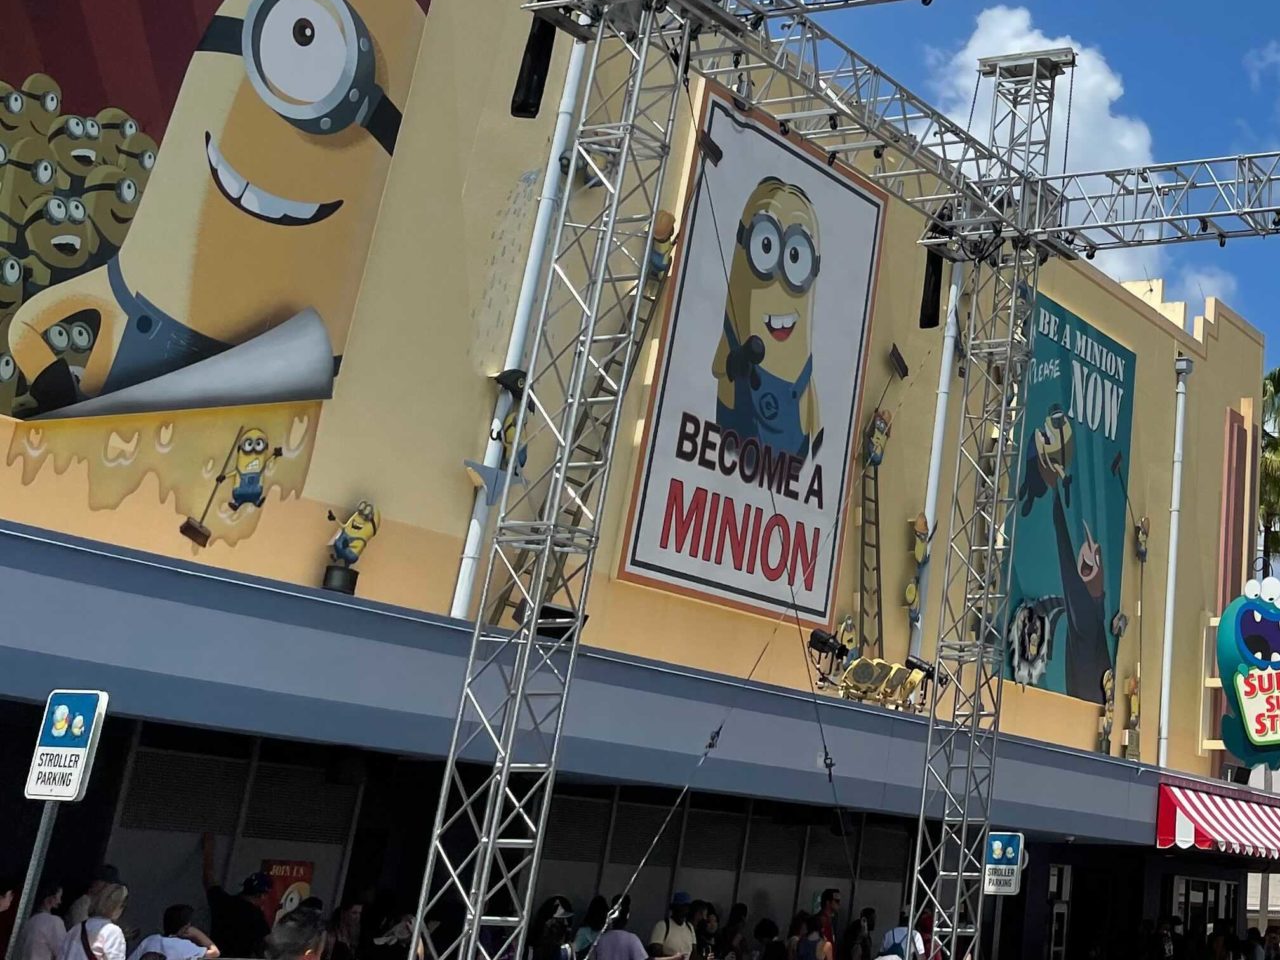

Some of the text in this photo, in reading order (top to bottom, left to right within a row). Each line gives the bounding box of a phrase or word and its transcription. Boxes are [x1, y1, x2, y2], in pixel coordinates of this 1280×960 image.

[1038, 307, 1126, 382] BE A MINION
[1068, 359, 1124, 441] NOW
[675, 411, 824, 510] BECOME A
[659, 477, 821, 592] MINION
[35, 771, 73, 787] PARKING
[38, 752, 80, 769] STROLLER
[987, 867, 1015, 877] STROLLER
[988, 878, 1012, 888] PARKING
